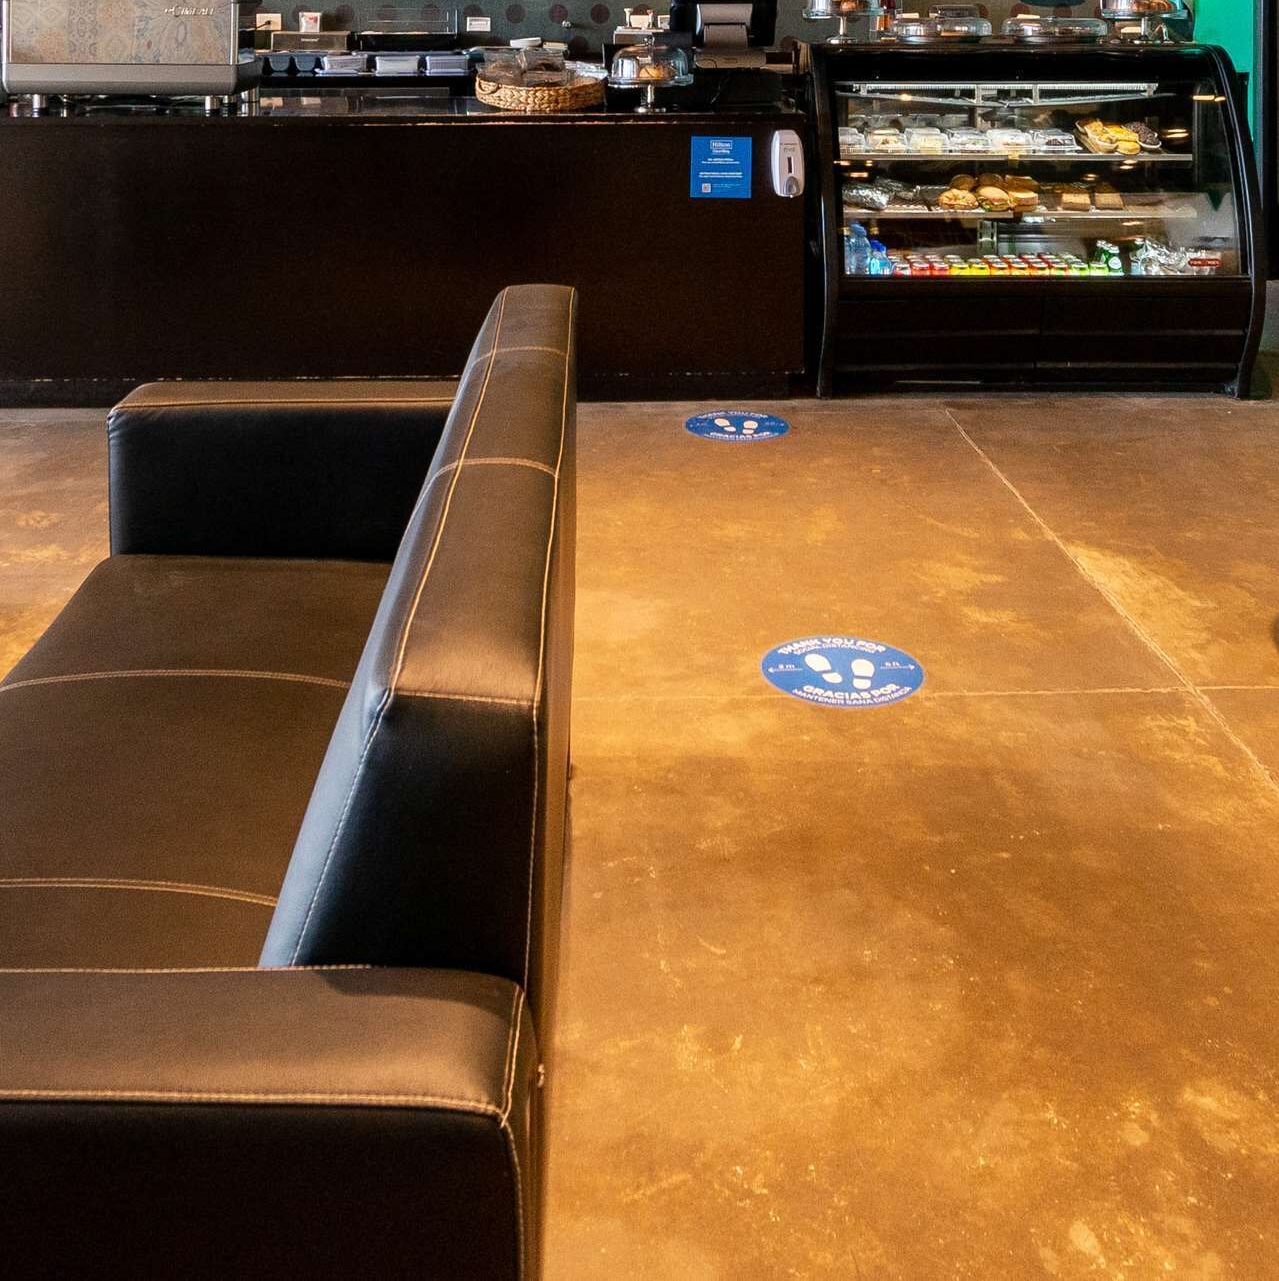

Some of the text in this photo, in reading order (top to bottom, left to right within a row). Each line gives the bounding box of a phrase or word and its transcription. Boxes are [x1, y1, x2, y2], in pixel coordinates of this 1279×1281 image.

[777, 637, 887, 655] THANK YOU FOR
[791, 688, 846, 705] MANTENER
[802, 683, 901, 700] GRACIAS POR
